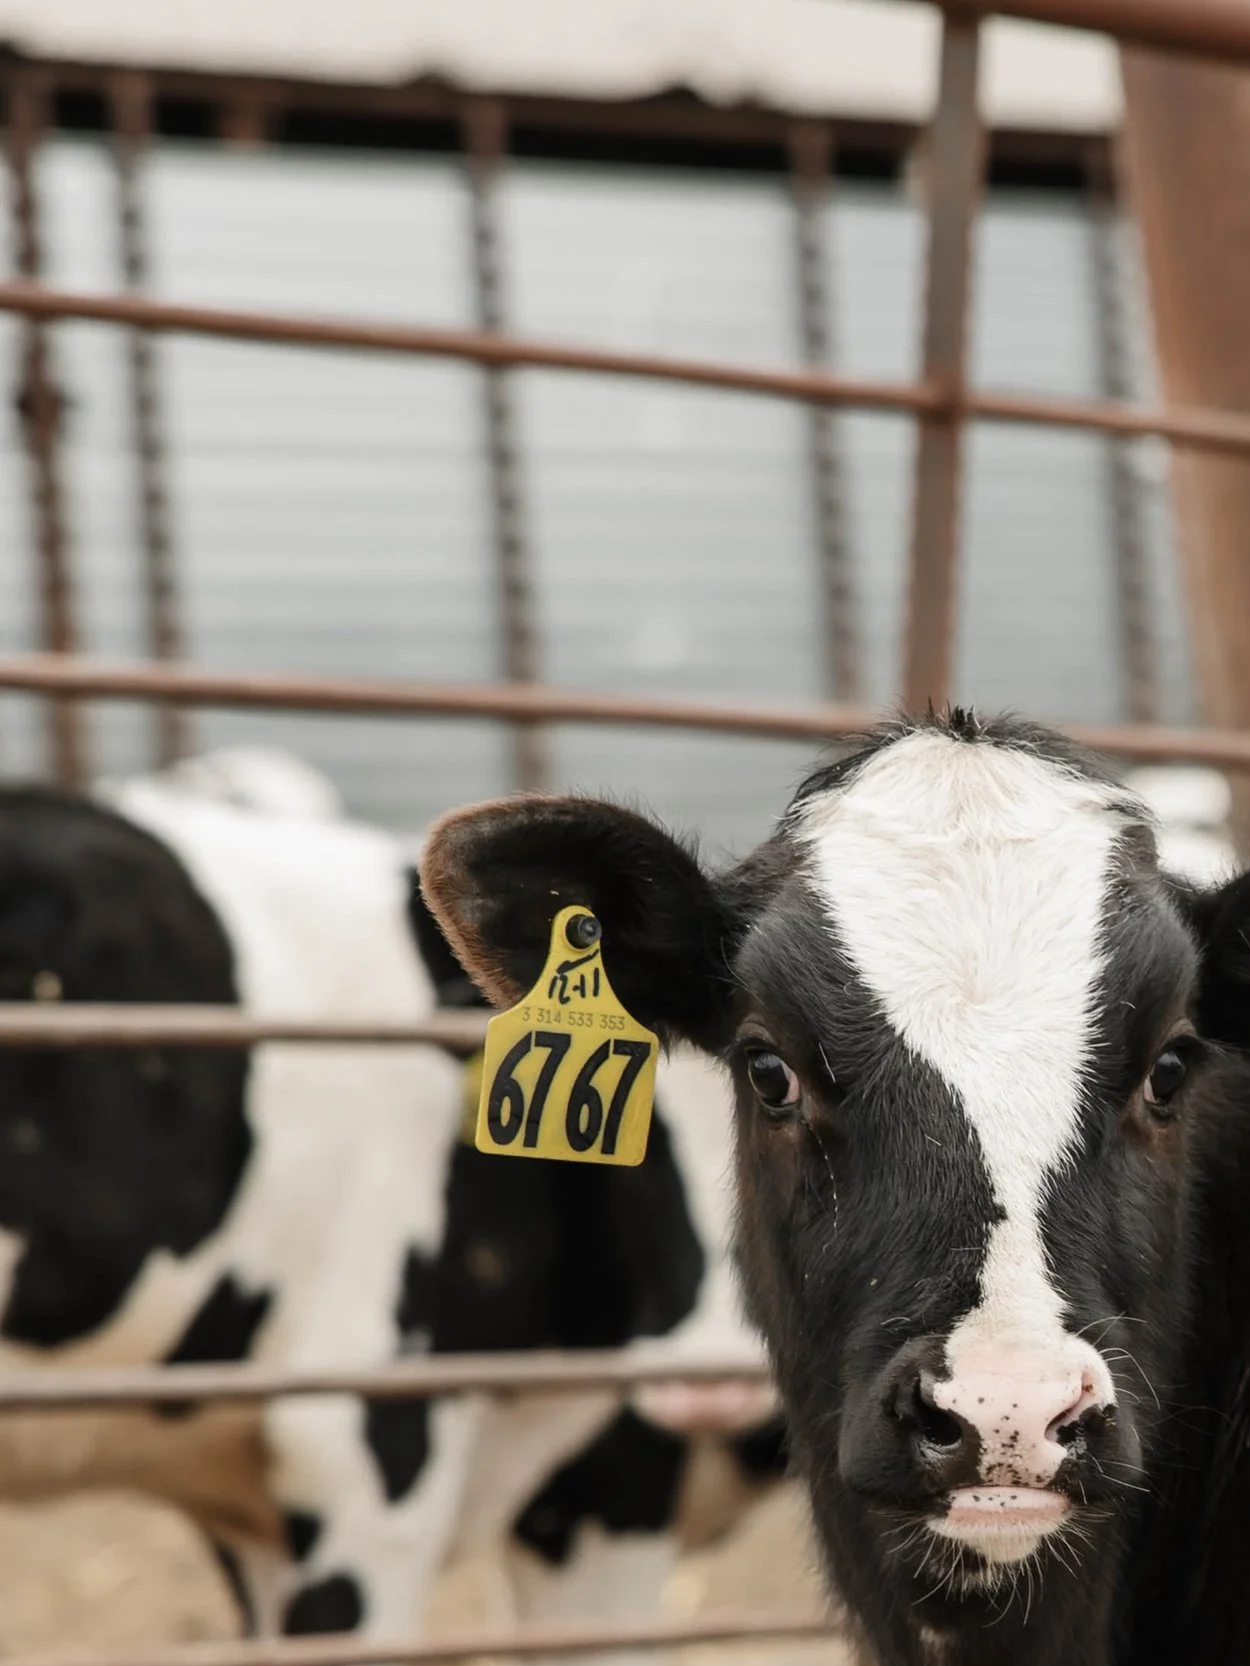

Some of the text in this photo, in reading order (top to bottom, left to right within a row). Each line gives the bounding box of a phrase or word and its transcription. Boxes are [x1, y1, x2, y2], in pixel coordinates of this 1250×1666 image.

[521, 1007, 626, 1032] 3 314 533 353
